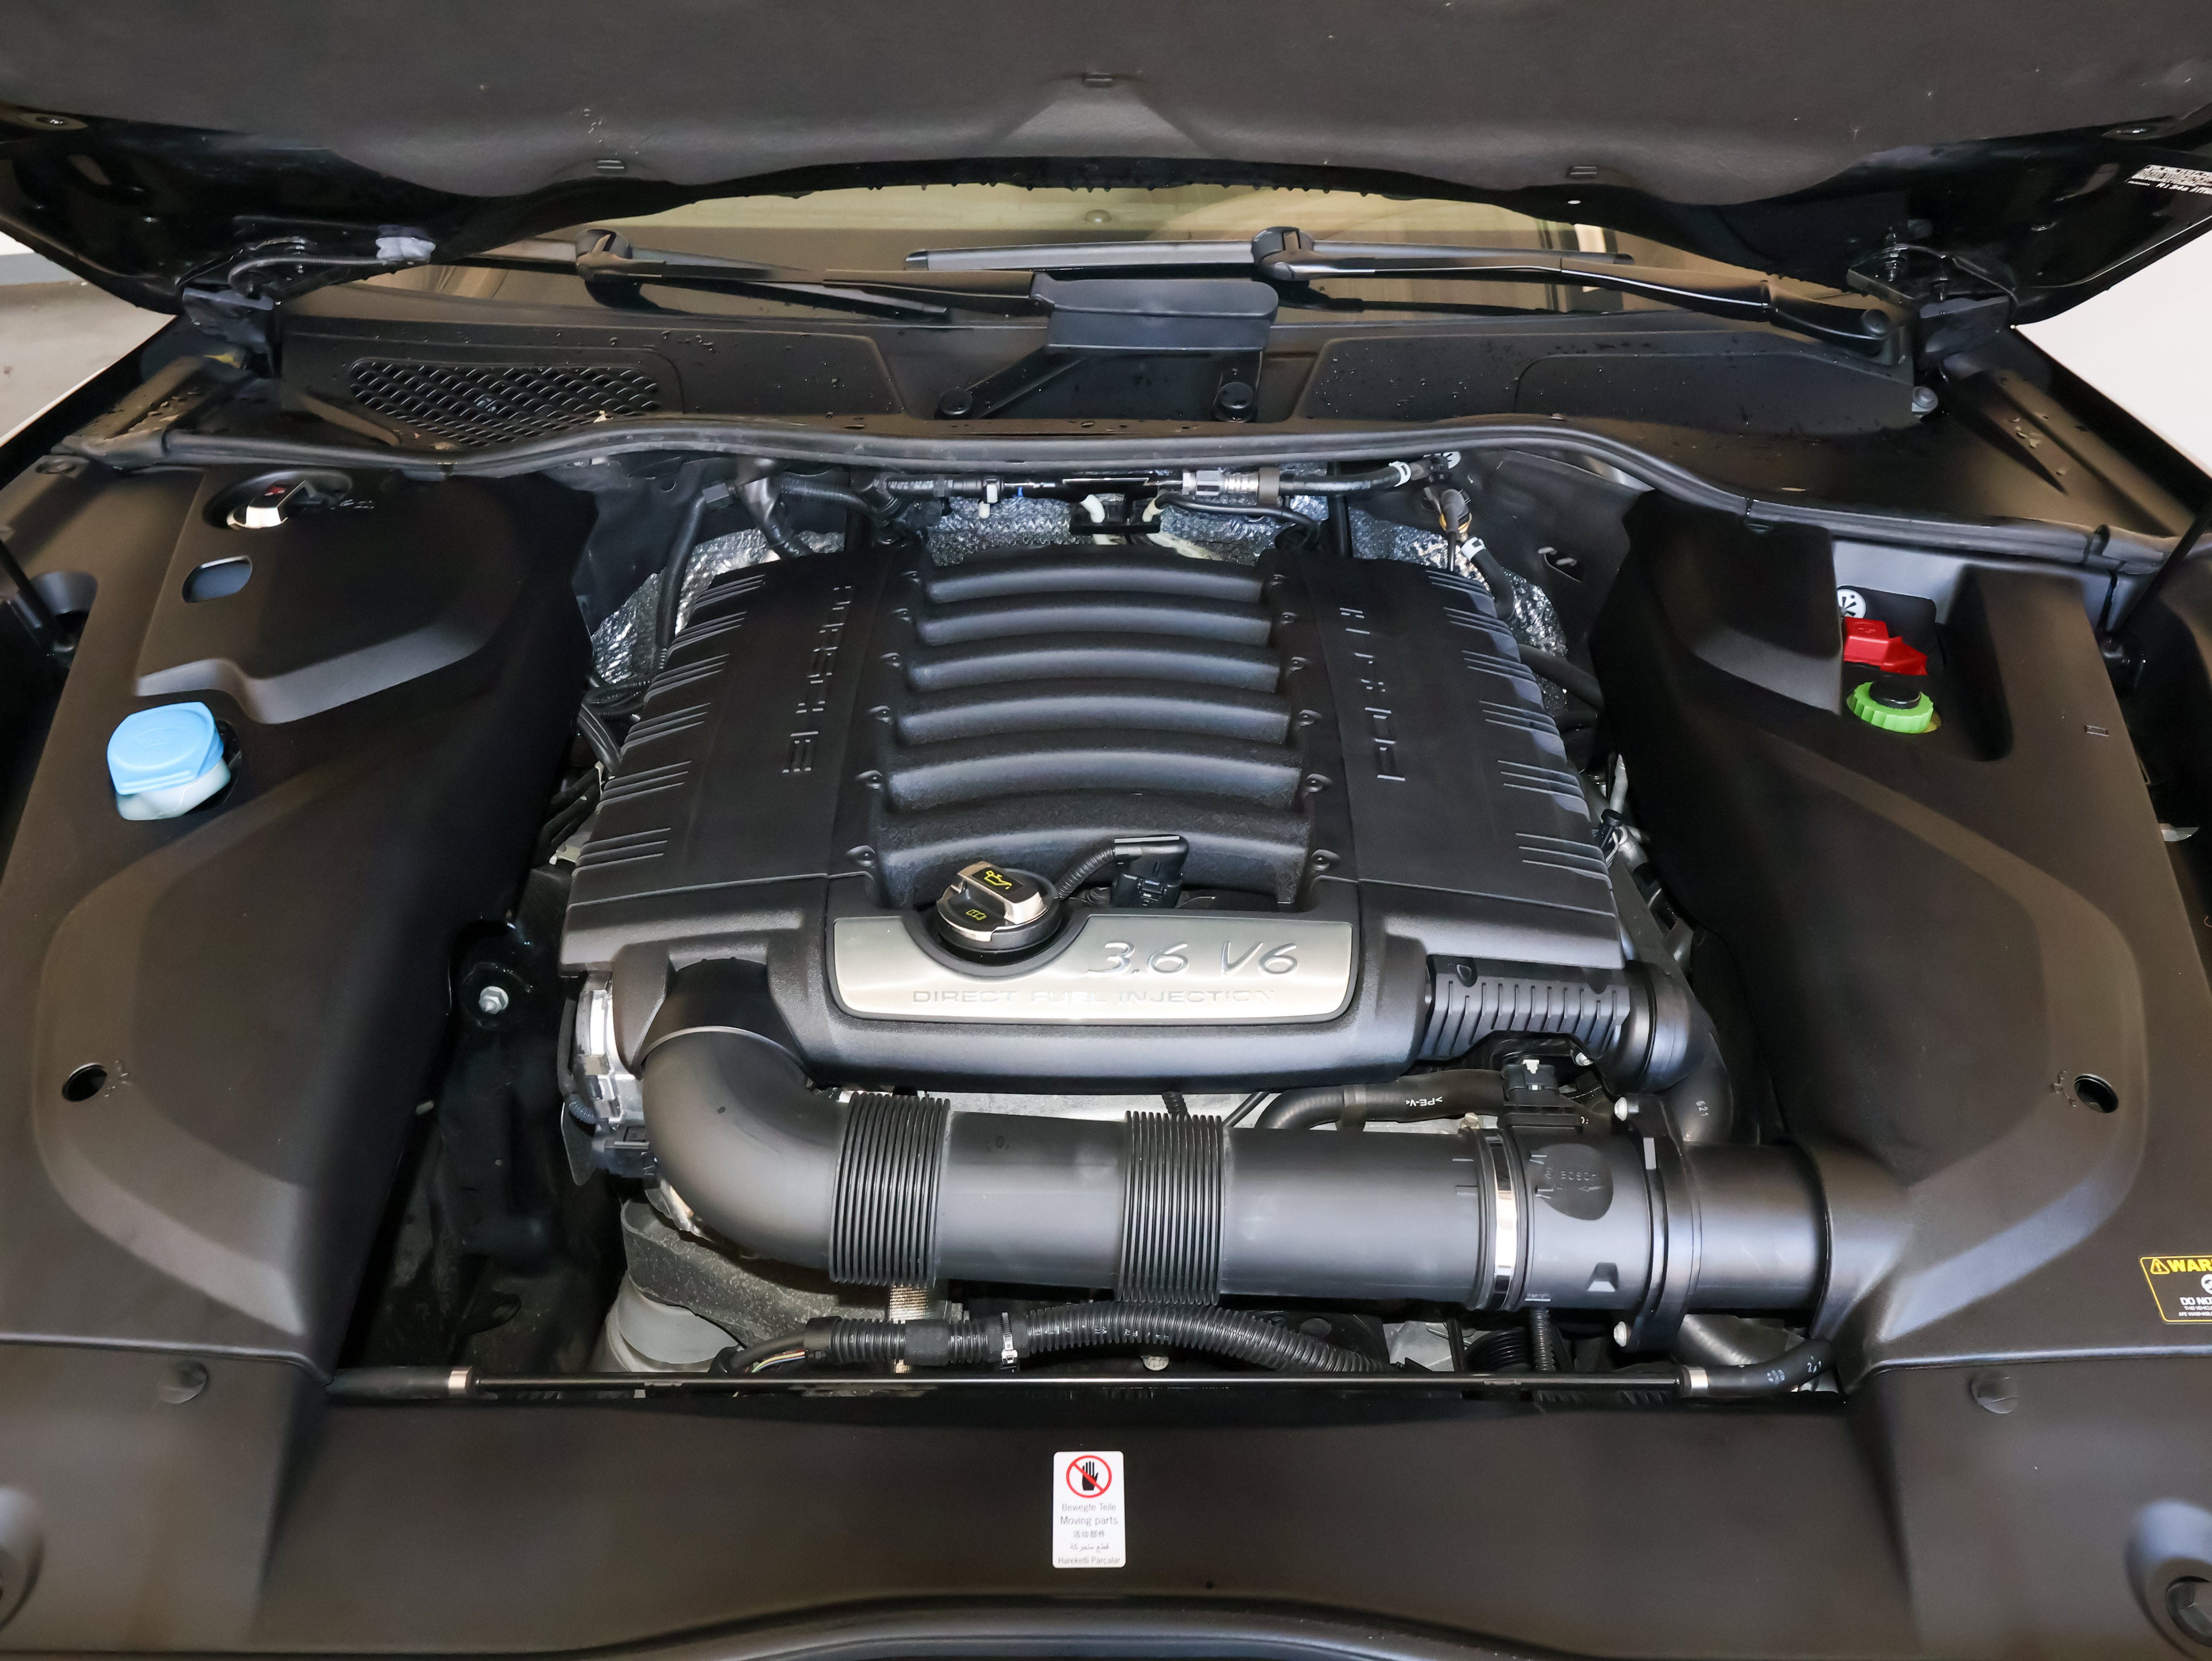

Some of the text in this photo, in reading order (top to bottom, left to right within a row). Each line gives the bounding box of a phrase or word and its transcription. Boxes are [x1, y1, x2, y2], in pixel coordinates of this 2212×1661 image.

[1085, 941, 1298, 977] 3.6 V6
[912, 990, 1275, 1004] DIRECT FUEL INJECTION
[2166, 1259, 2212, 1272] WAR
[2180, 1297, 2196, 1306] DO
[1062, 1502, 1116, 1512] Bewegte Teile
[1060, 1516, 1118, 1526] Moving parts
[1091, 1556, 1120, 1565] Parçalar
